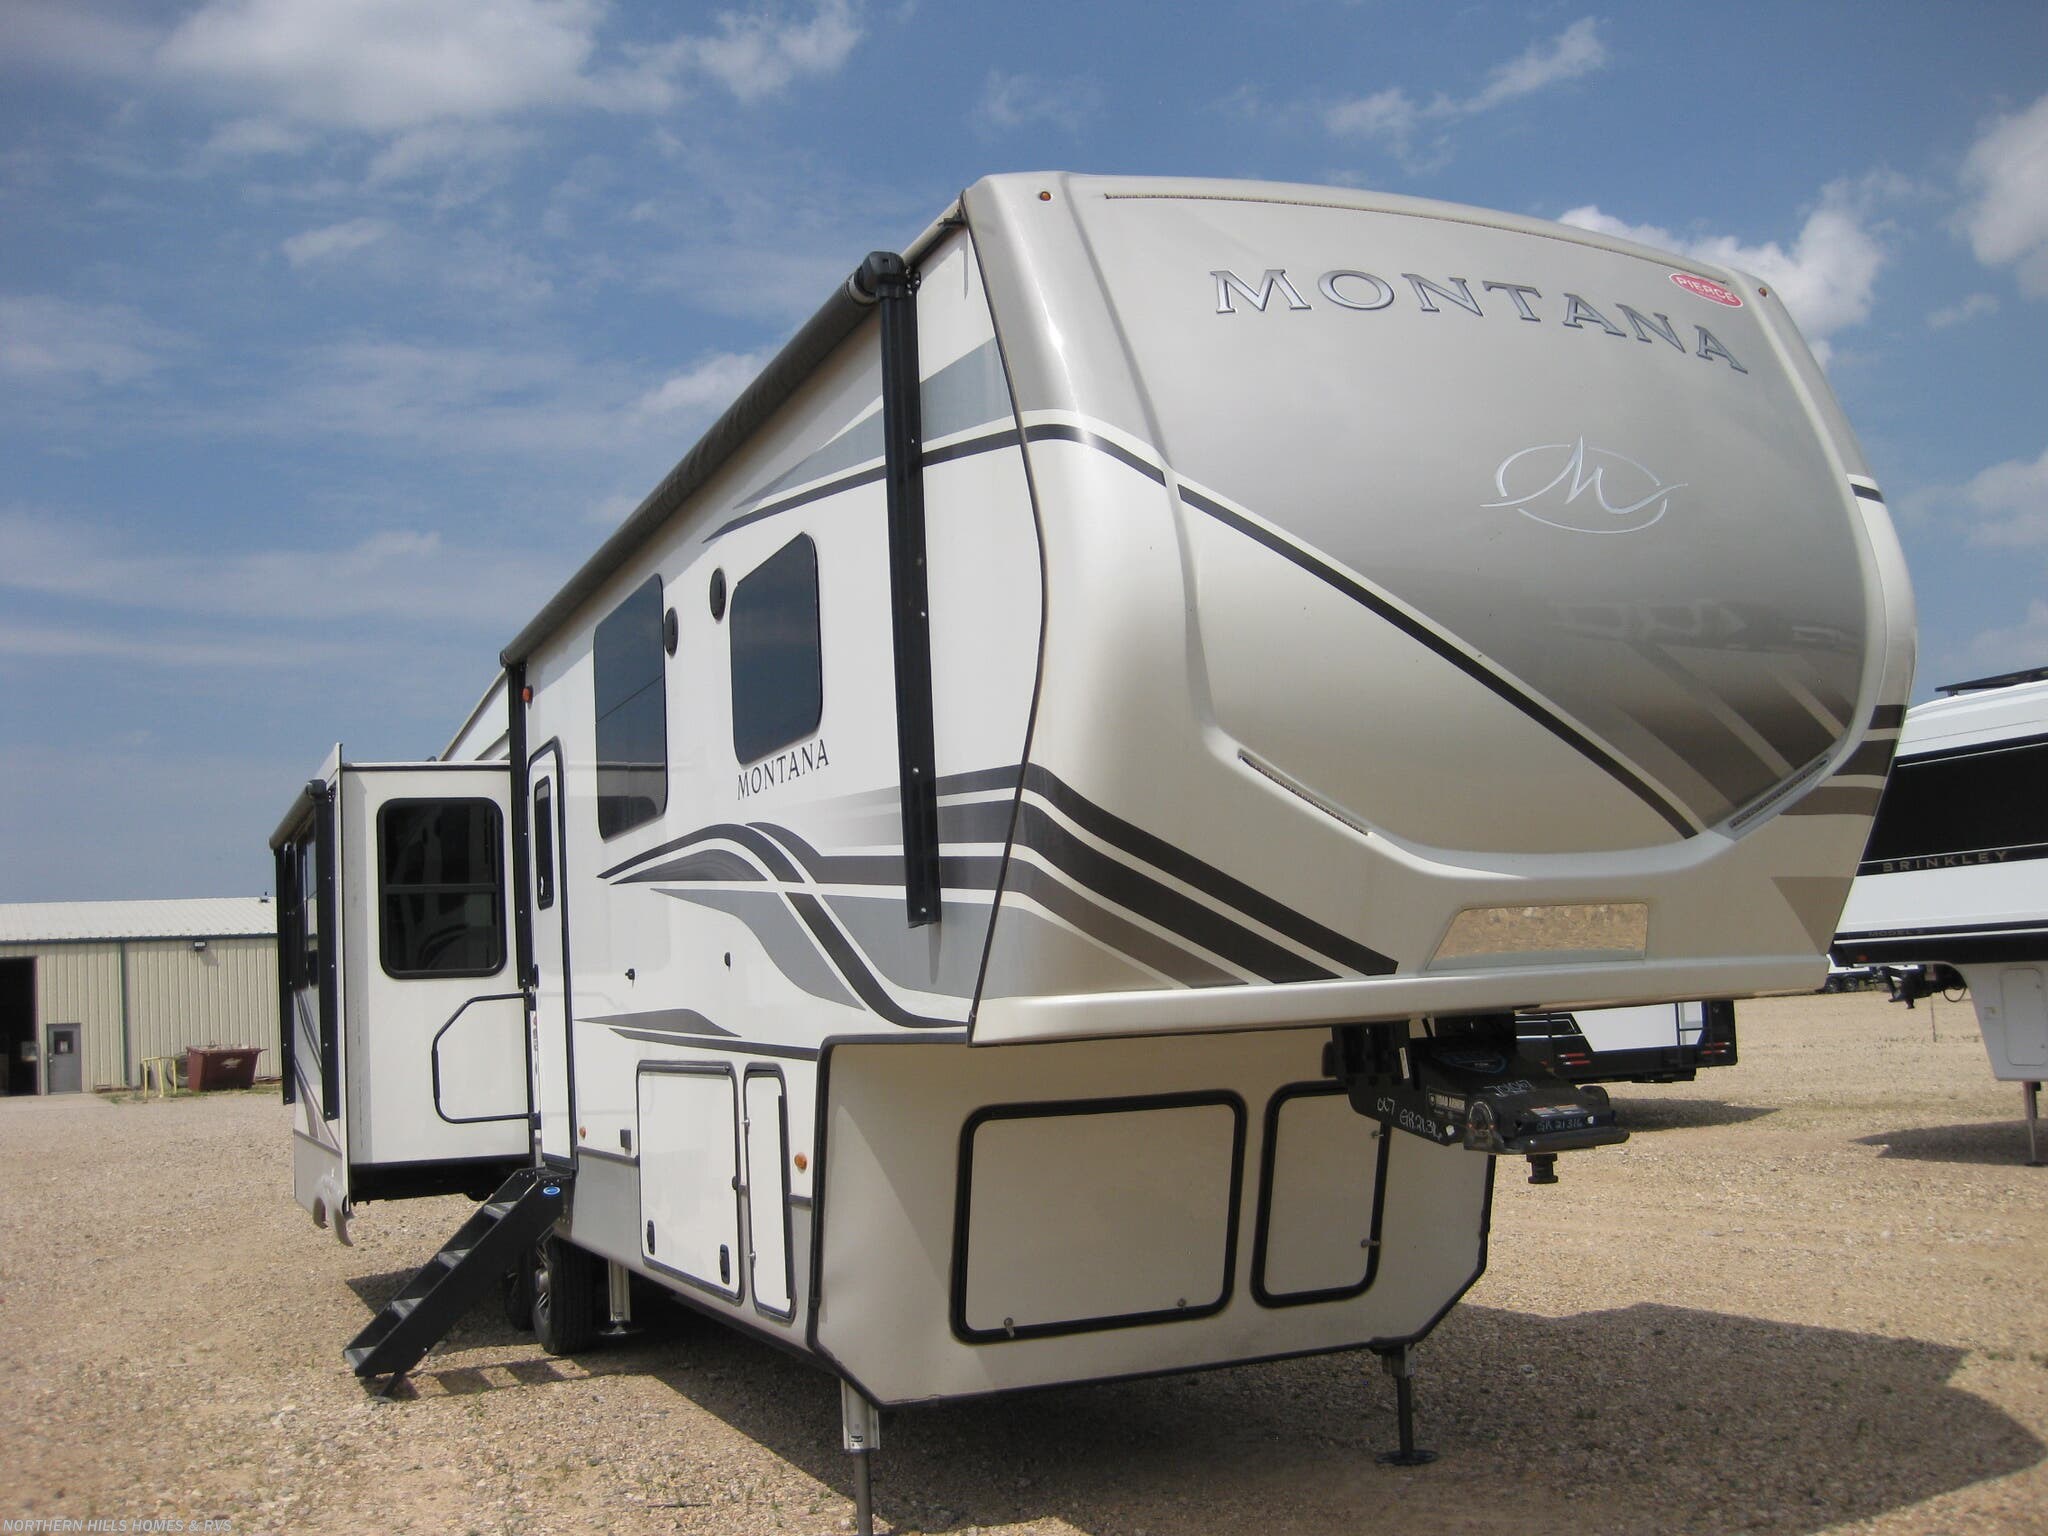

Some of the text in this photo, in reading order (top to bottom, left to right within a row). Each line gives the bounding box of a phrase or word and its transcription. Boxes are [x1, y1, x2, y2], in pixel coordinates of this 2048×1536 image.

[1674, 276, 1736, 303] PIERCE
[1210, 268, 1749, 375] MONTANA
[737, 738, 830, 801] MONTANA
[1882, 850, 2008, 873] BRINKLEY
